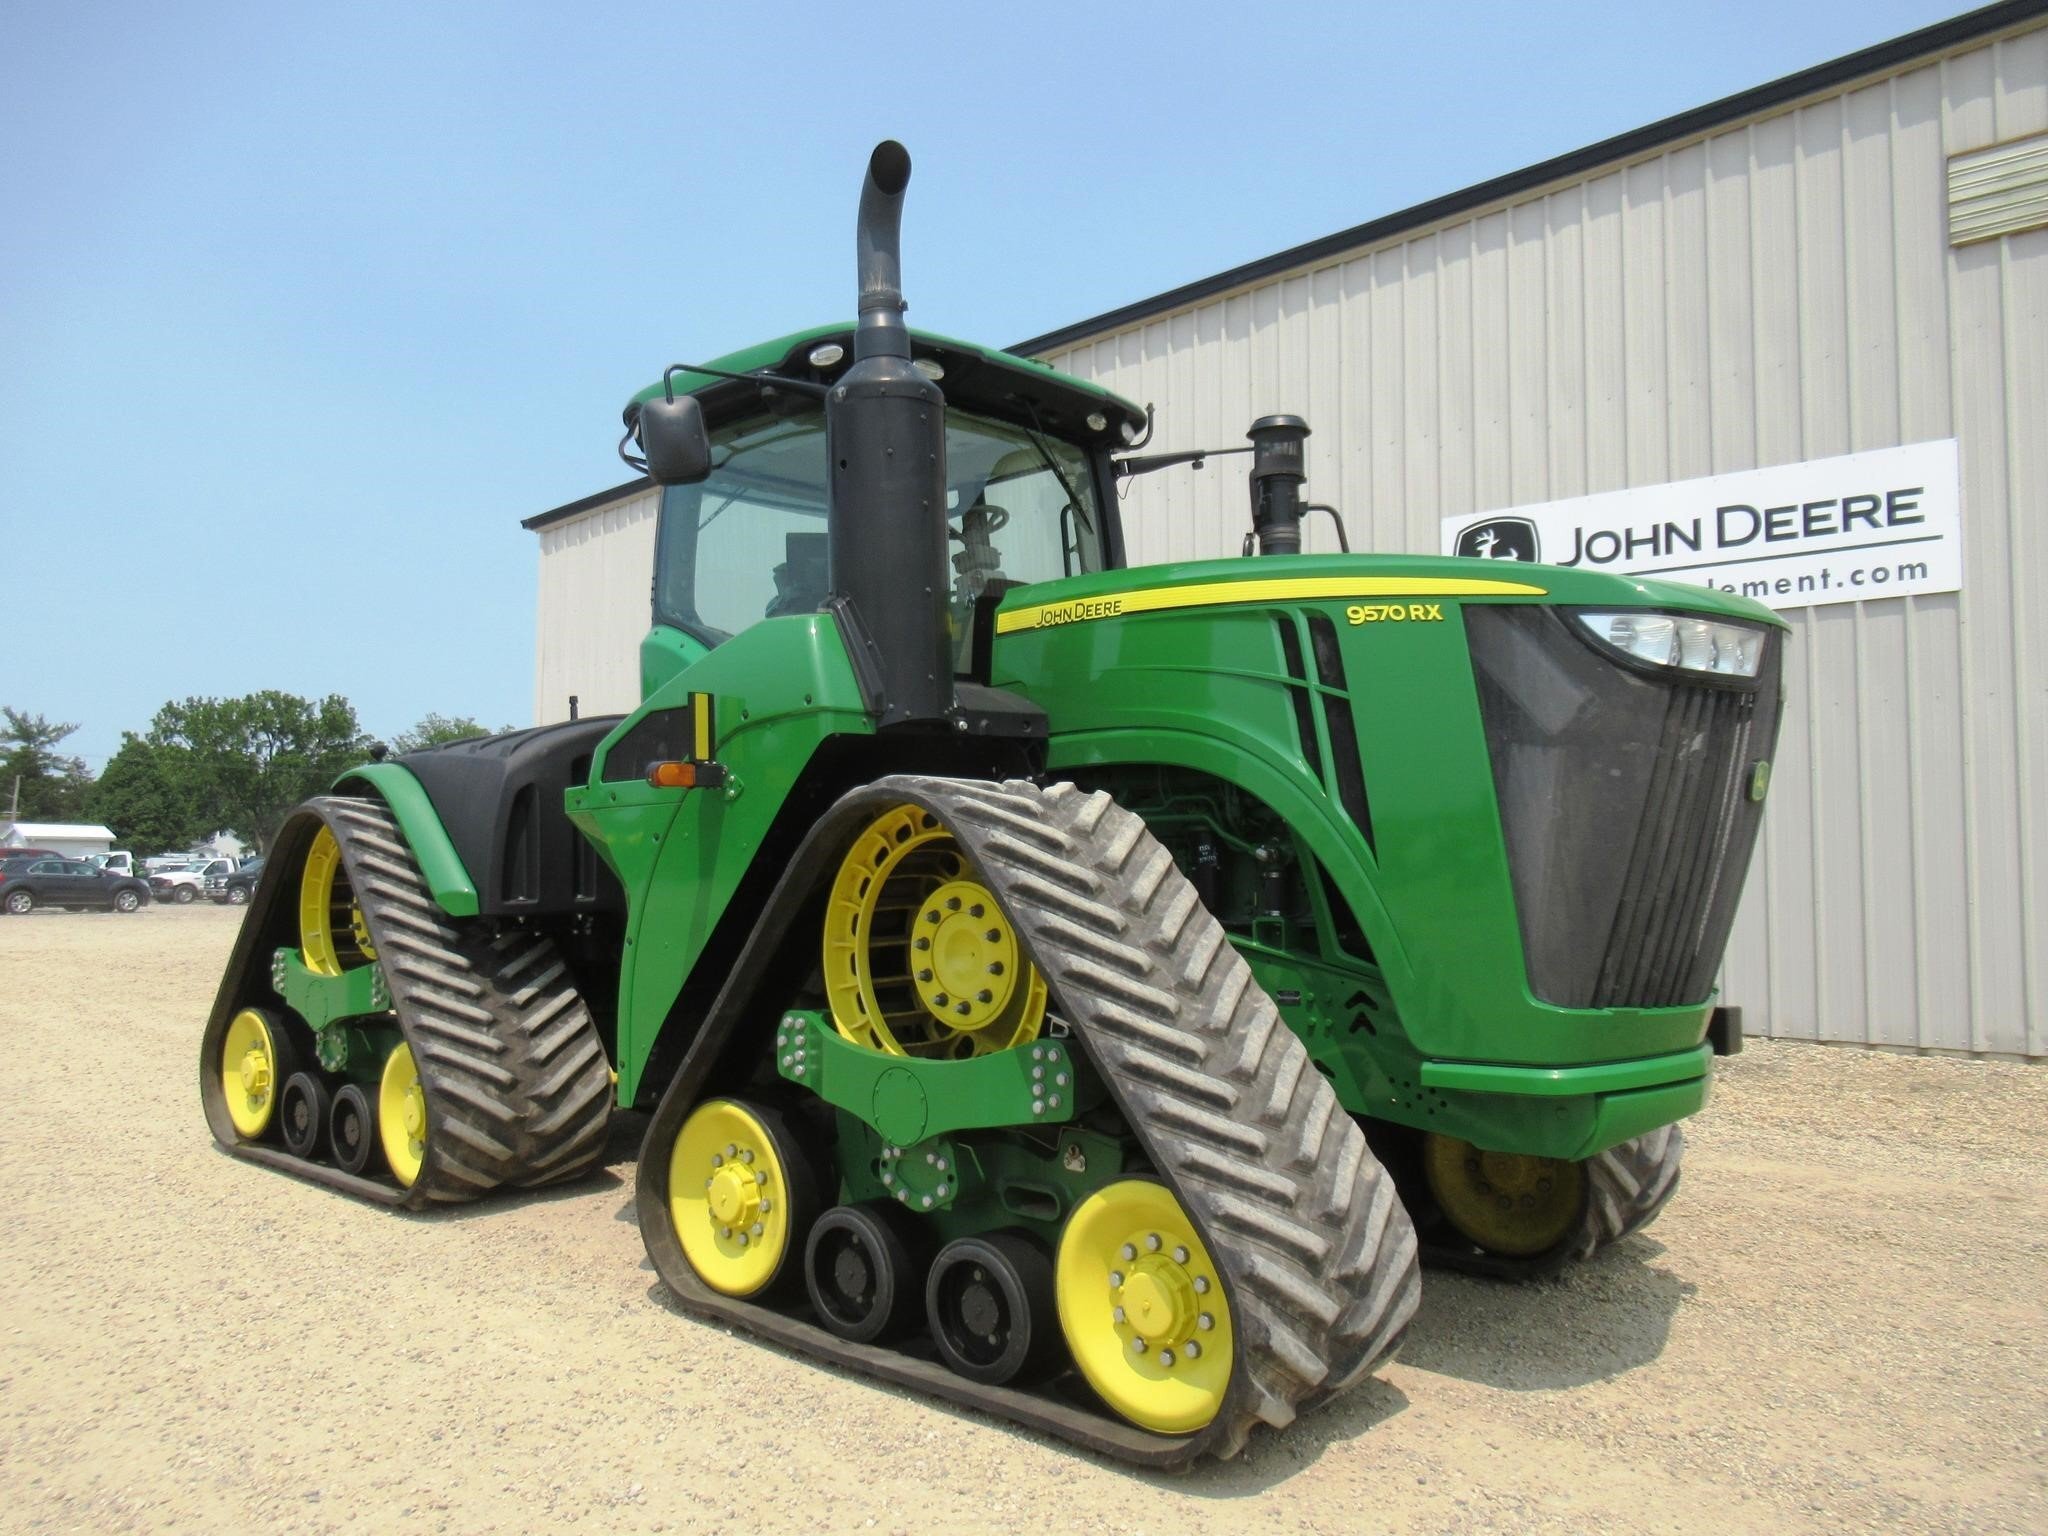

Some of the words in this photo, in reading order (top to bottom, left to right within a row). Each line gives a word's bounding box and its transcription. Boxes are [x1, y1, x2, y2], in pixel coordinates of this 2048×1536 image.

[1556, 517, 1702, 567] JOHN
[1717, 487, 1925, 549] DEERE
[1036, 608, 1072, 626] JOHN
[1074, 600, 1123, 620] DEERE
[1346, 605, 1406, 625] 9570
[1408, 604, 1444, 621] RX
